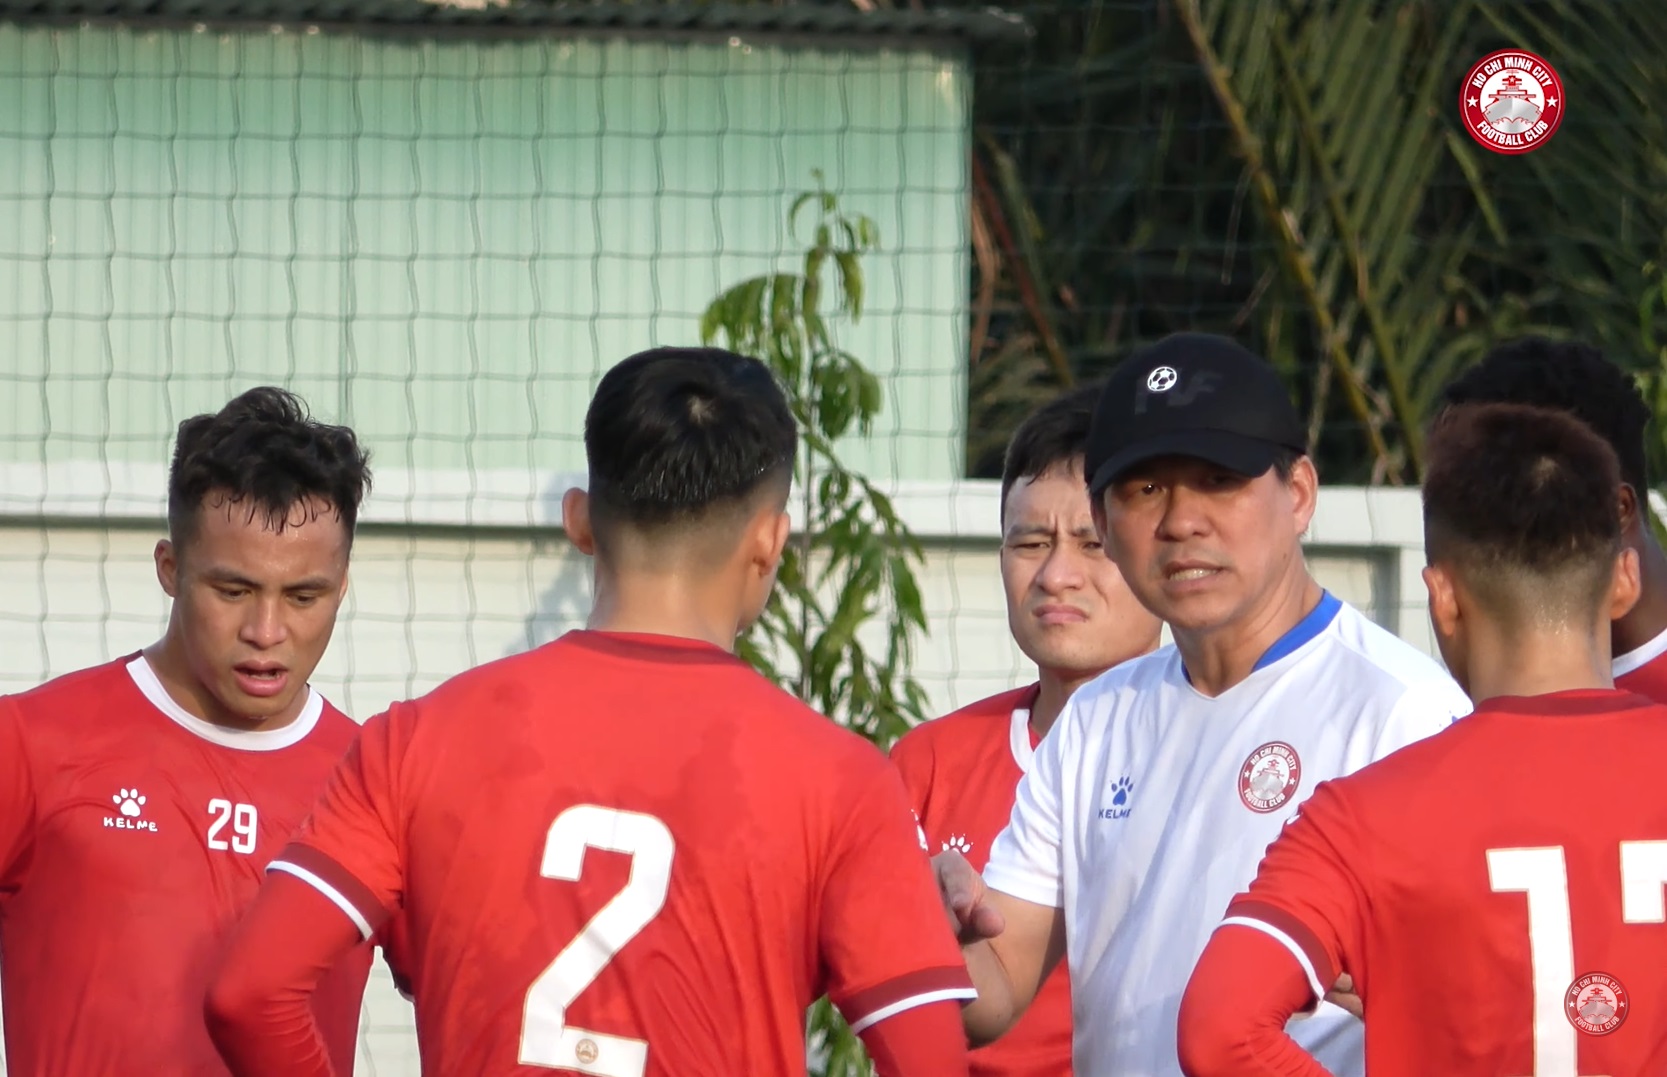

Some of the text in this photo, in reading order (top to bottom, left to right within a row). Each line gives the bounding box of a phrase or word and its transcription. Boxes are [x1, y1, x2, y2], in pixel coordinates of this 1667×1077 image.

[1250, 746, 1297, 770] HO CHI MINH CITY
[1244, 788, 1286, 808] FOOTBALL CLUB
[103, 816, 158, 832] KELME
[207, 798, 258, 855] 29
[518, 803, 676, 1077] 2
